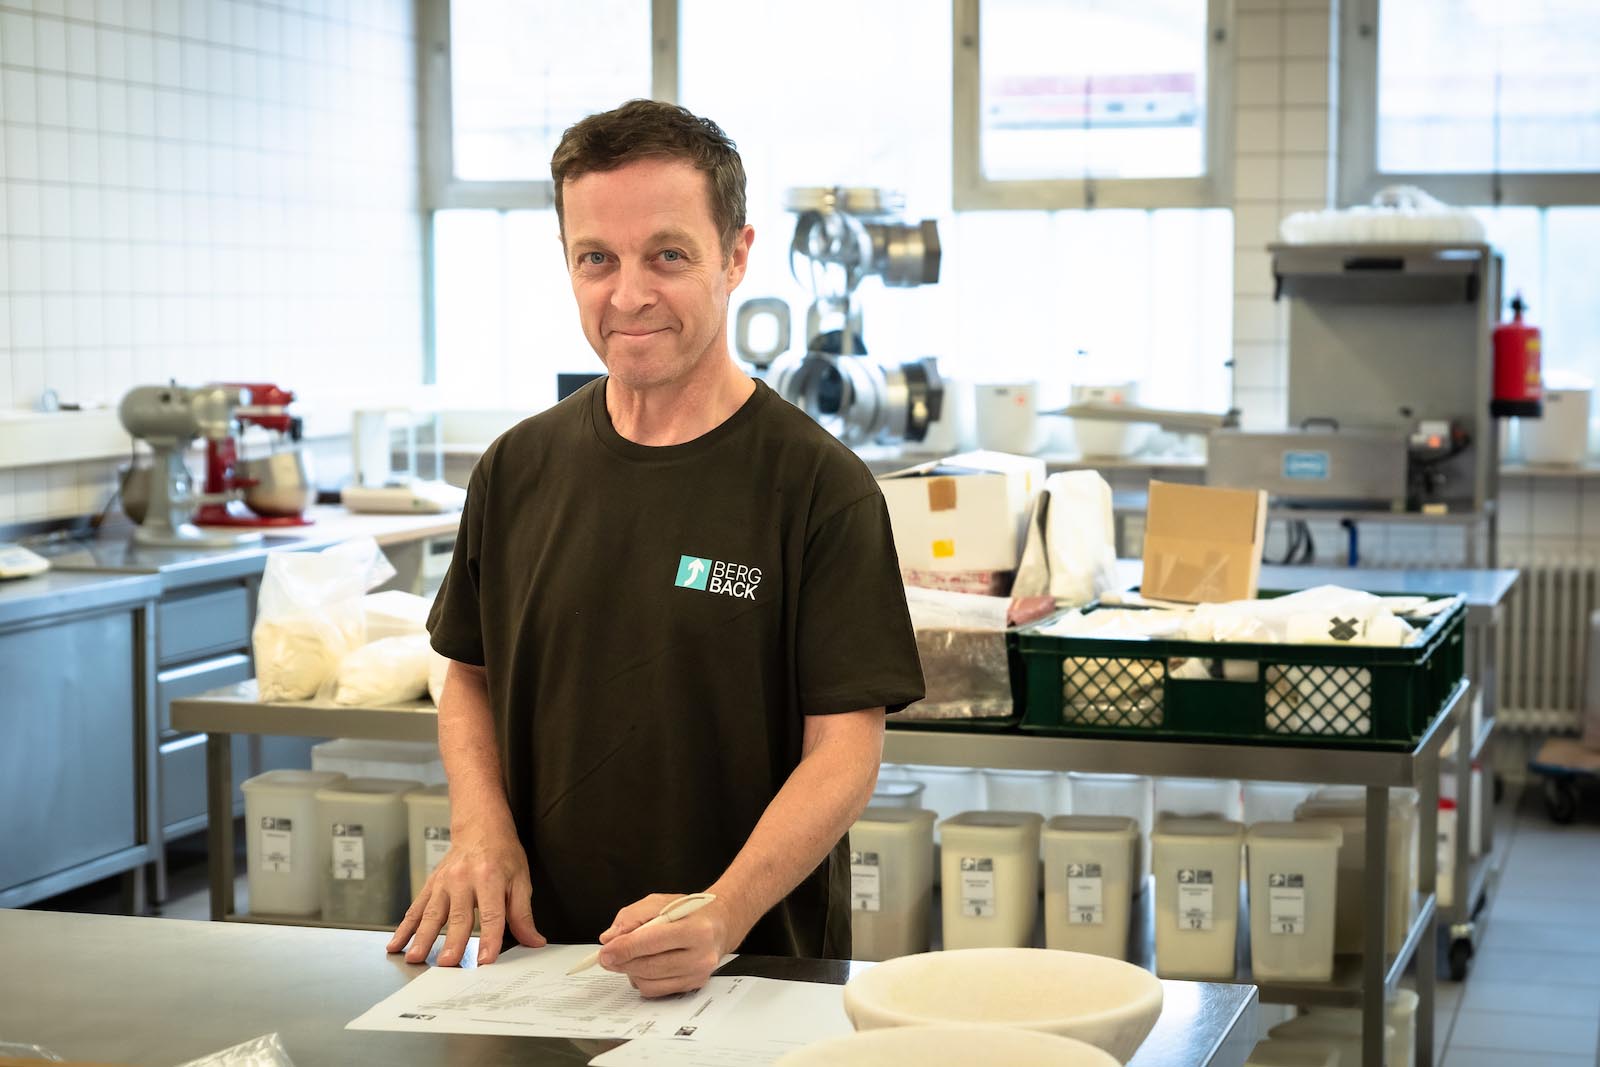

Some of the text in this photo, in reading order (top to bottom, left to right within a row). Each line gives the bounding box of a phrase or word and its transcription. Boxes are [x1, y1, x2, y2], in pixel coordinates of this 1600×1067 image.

[712, 560, 763, 585] BERG
[709, 577, 759, 601] BACK
[1080, 912, 1093, 923] 10
[1189, 919, 1202, 929] 12
[1281, 923, 1295, 933] 13
